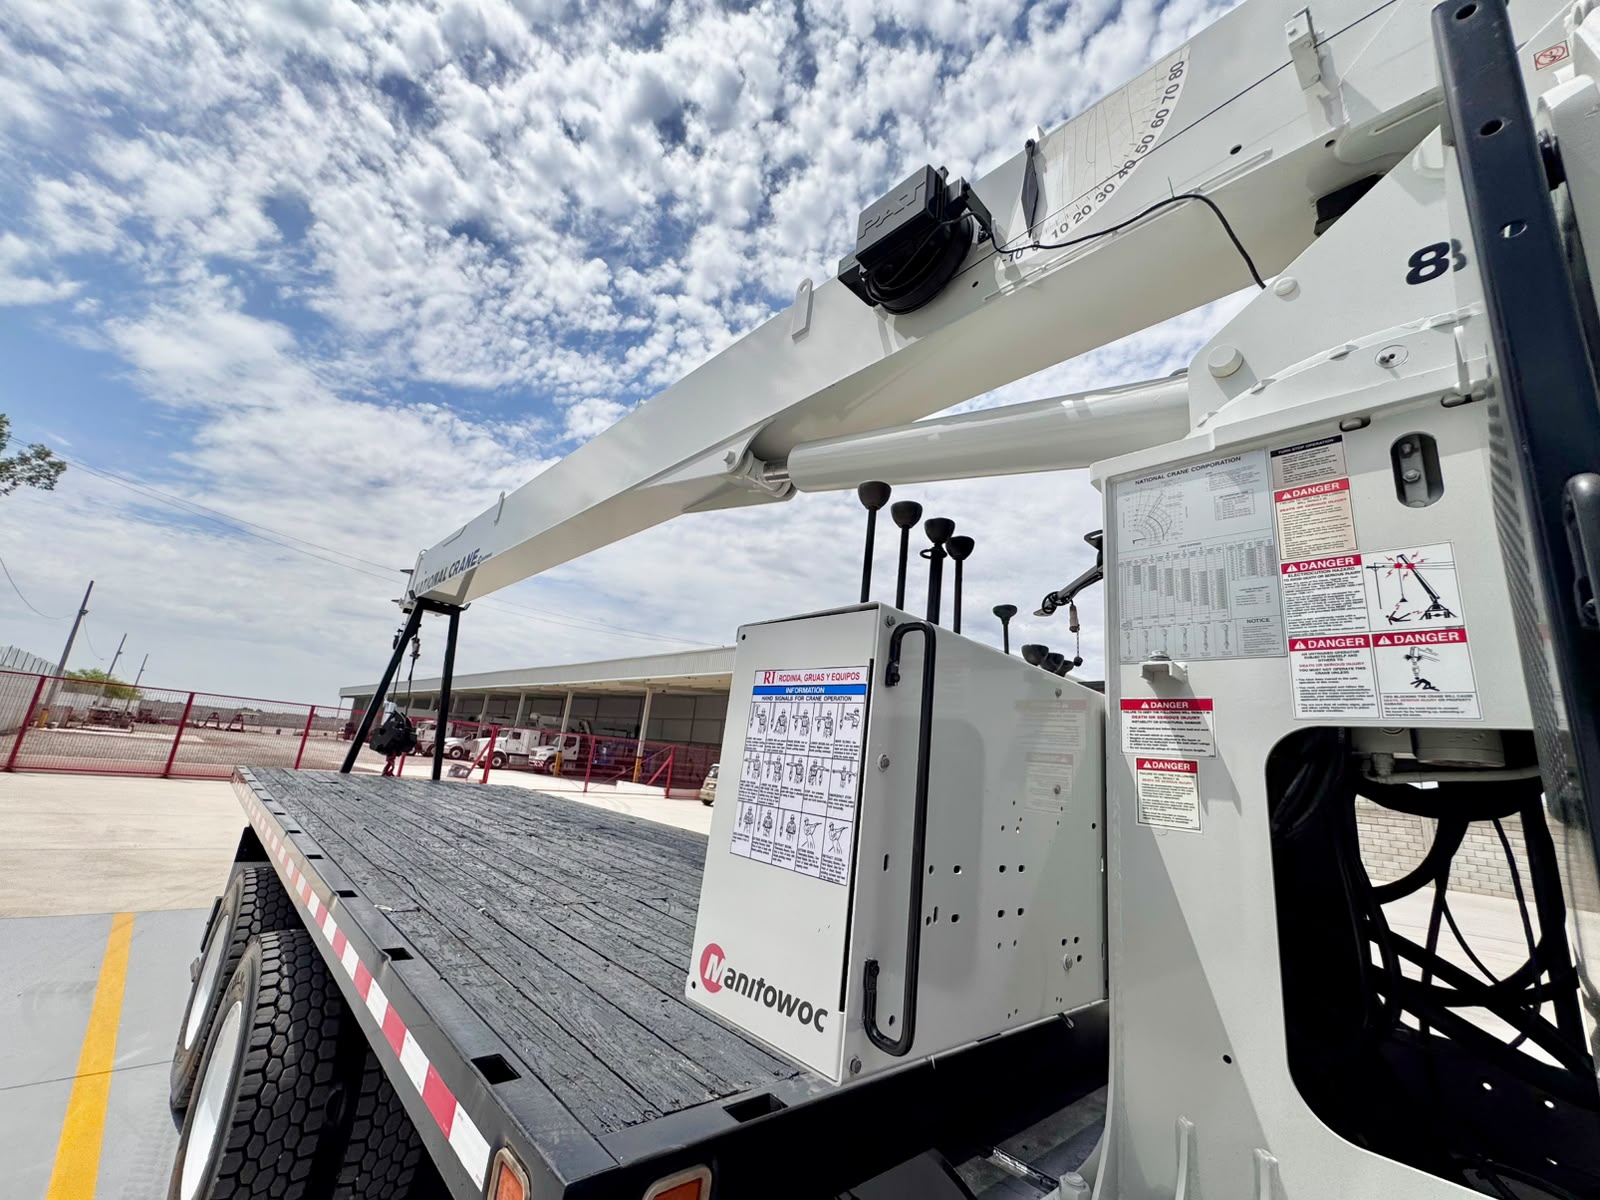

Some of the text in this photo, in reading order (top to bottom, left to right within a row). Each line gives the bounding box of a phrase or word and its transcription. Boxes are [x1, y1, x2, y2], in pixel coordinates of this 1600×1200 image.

[1168, 60, 1185, 82] 80
[1161, 83, 1180, 105] 70
[1151, 108, 1170, 129] 60
[1135, 134, 1155, 154] 50
[1118, 160, 1136, 179] 40
[1095, 183, 1115, 203] 30
[1073, 204, 1092, 224] 20
[1051, 222, 1069, 239] 10
[1135, 456, 1241, 485] NATIONAL CRANE CORPORATION
[1292, 482, 1340, 498] DANGER
[448, 547, 481, 578] CRANE
[1299, 556, 1355, 571] DANGER
[1307, 637, 1365, 649] DANGER
[1393, 631, 1460, 644] DANGER
[763, 671, 776, 685] RI
[778, 674, 803, 683] RODINIA,
[803, 673, 825, 682] GRUAS
[831, 671, 861, 681] EQUIPOS
[785, 686, 825, 694] INFORMATION
[1150, 701, 1189, 709] DANGER
[1152, 760, 1191, 771] DANGER
[703, 952, 829, 1034] Manitowoc
